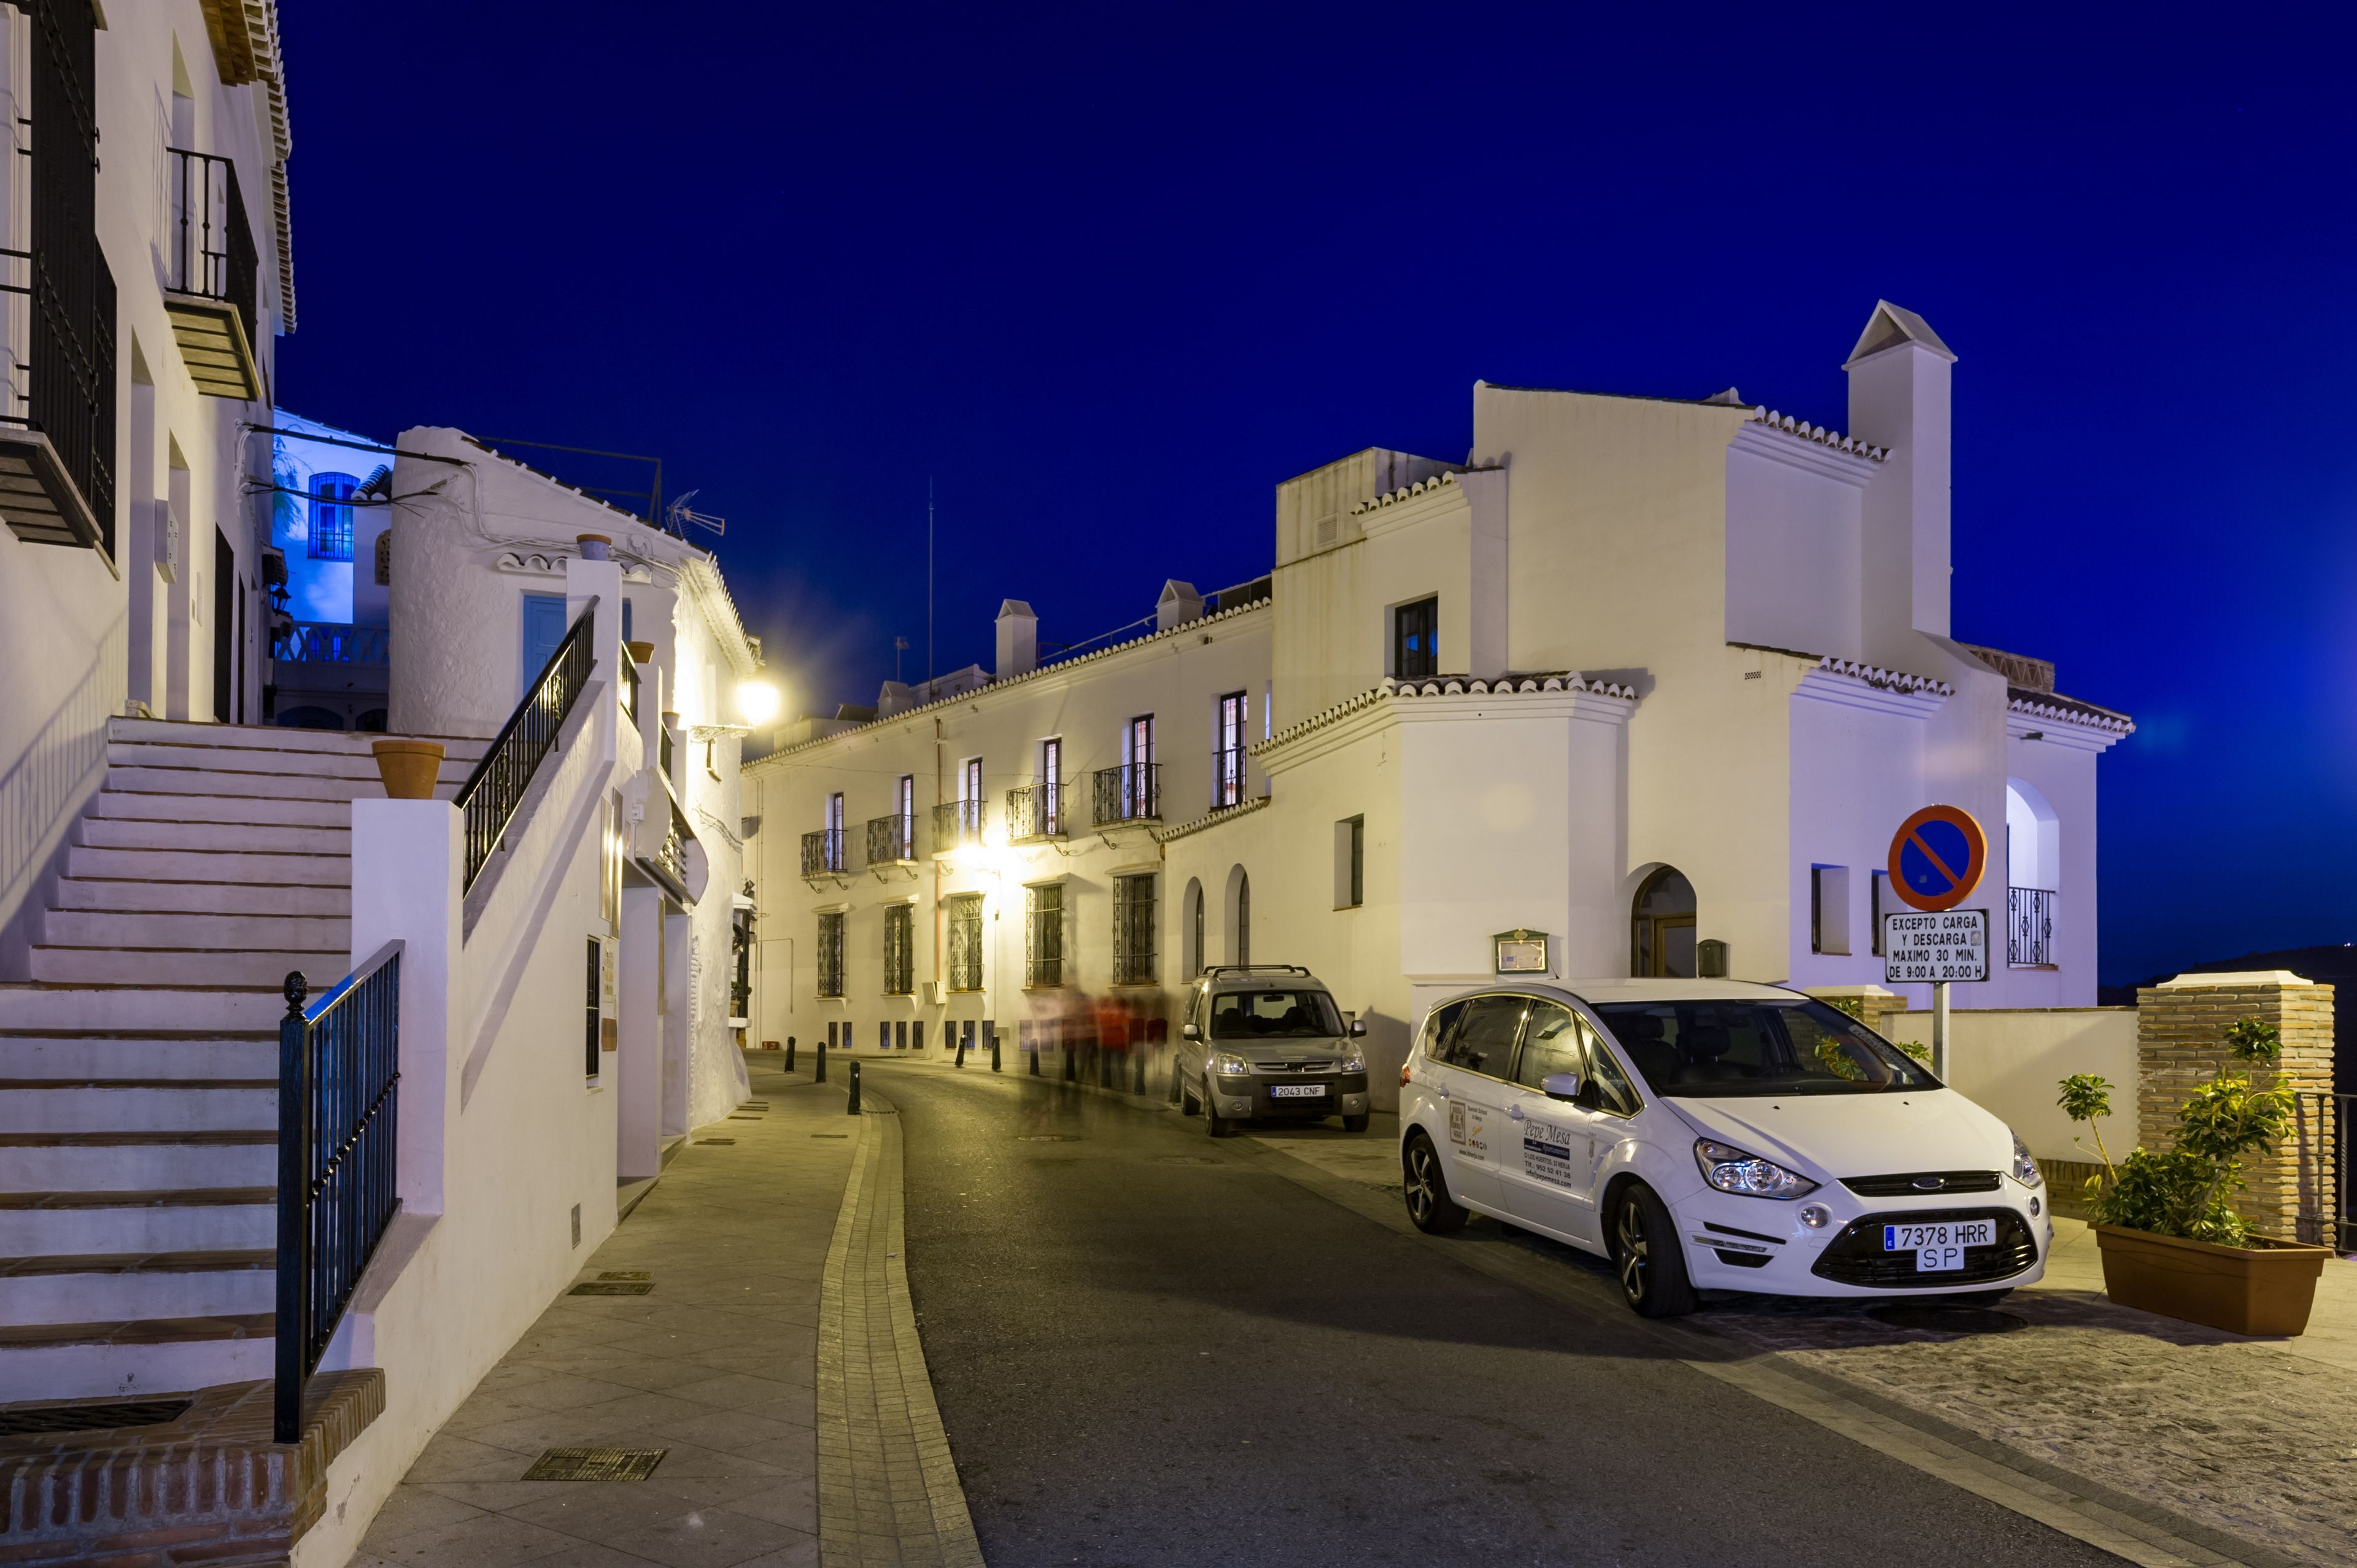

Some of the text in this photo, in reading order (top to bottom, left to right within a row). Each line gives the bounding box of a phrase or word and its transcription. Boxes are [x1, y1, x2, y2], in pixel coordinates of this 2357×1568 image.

[1892, 916, 1978, 930] EXCEPTO CARGA
[1902, 932, 1967, 946] Y DESCARGA
[1893, 949, 1977, 962] MAXIMO 30 MIN.
[1889, 965, 1982, 978] DE 9:00 A 20:00 H
[1278, 1087, 1301, 1096] 2043
[1304, 1086, 1320, 1095] CNF
[1523, 1119, 1571, 1145] Pepe Mesa
[1536, 1164, 1546, 1172] 952
[1902, 1224, 1988, 1247] 7378 HRR
[1924, 1248, 1958, 1268] SP
